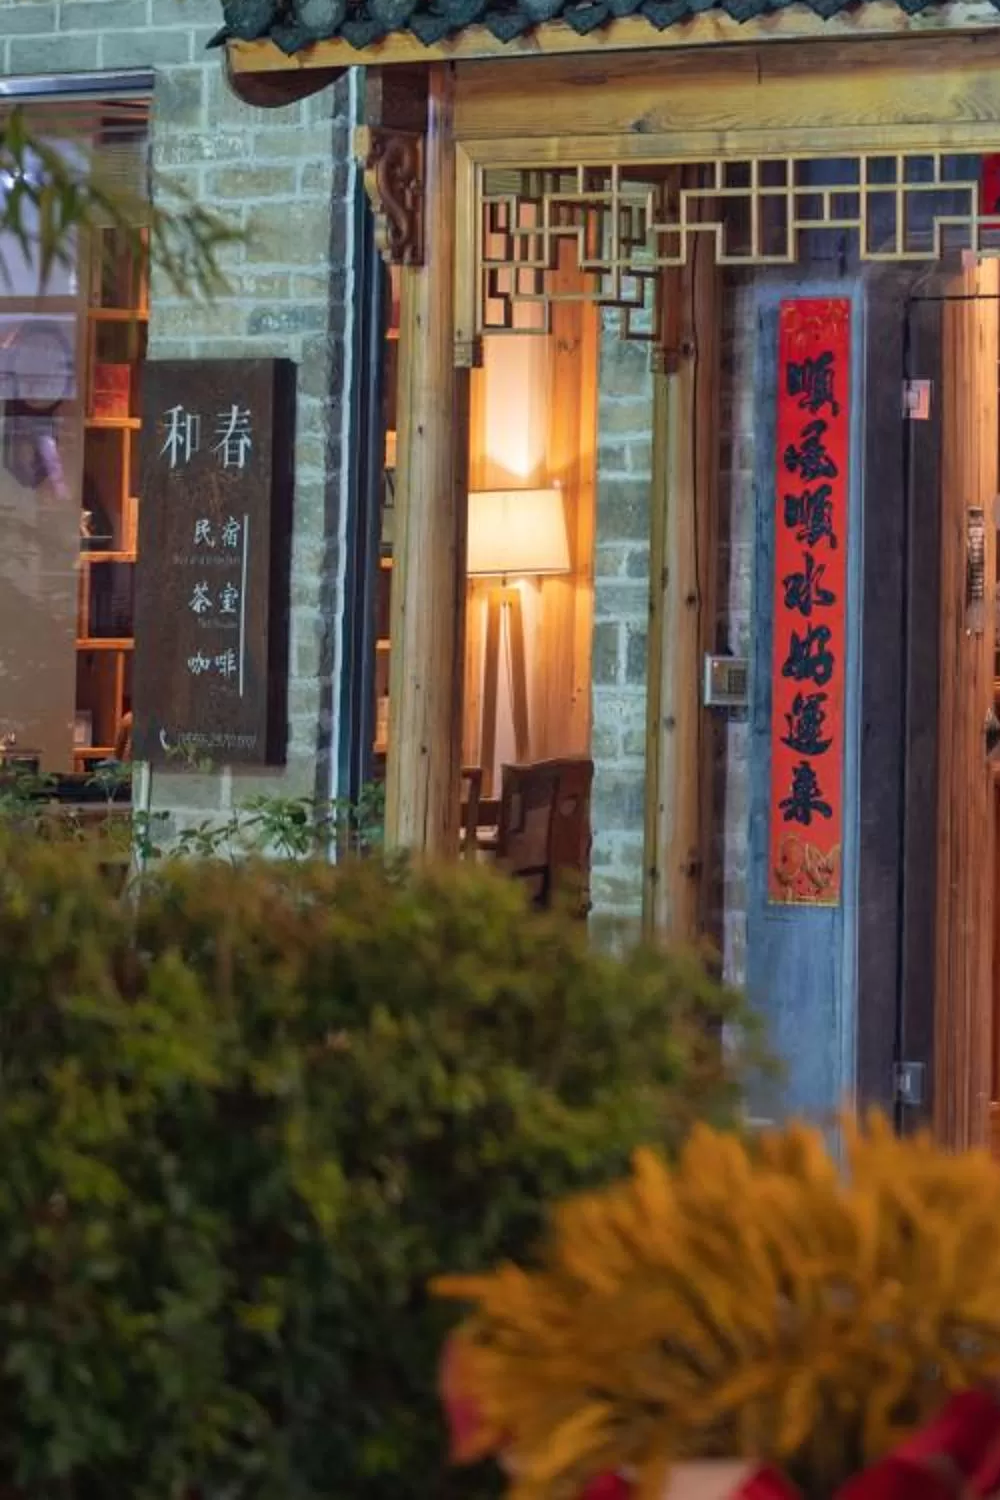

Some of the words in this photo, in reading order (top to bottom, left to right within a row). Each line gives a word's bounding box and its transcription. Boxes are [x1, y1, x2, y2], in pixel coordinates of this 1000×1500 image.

[193, 515, 241, 549] 民宿
[187, 581, 239, 613] 茶室
[187, 648, 237, 679] 咖啡
